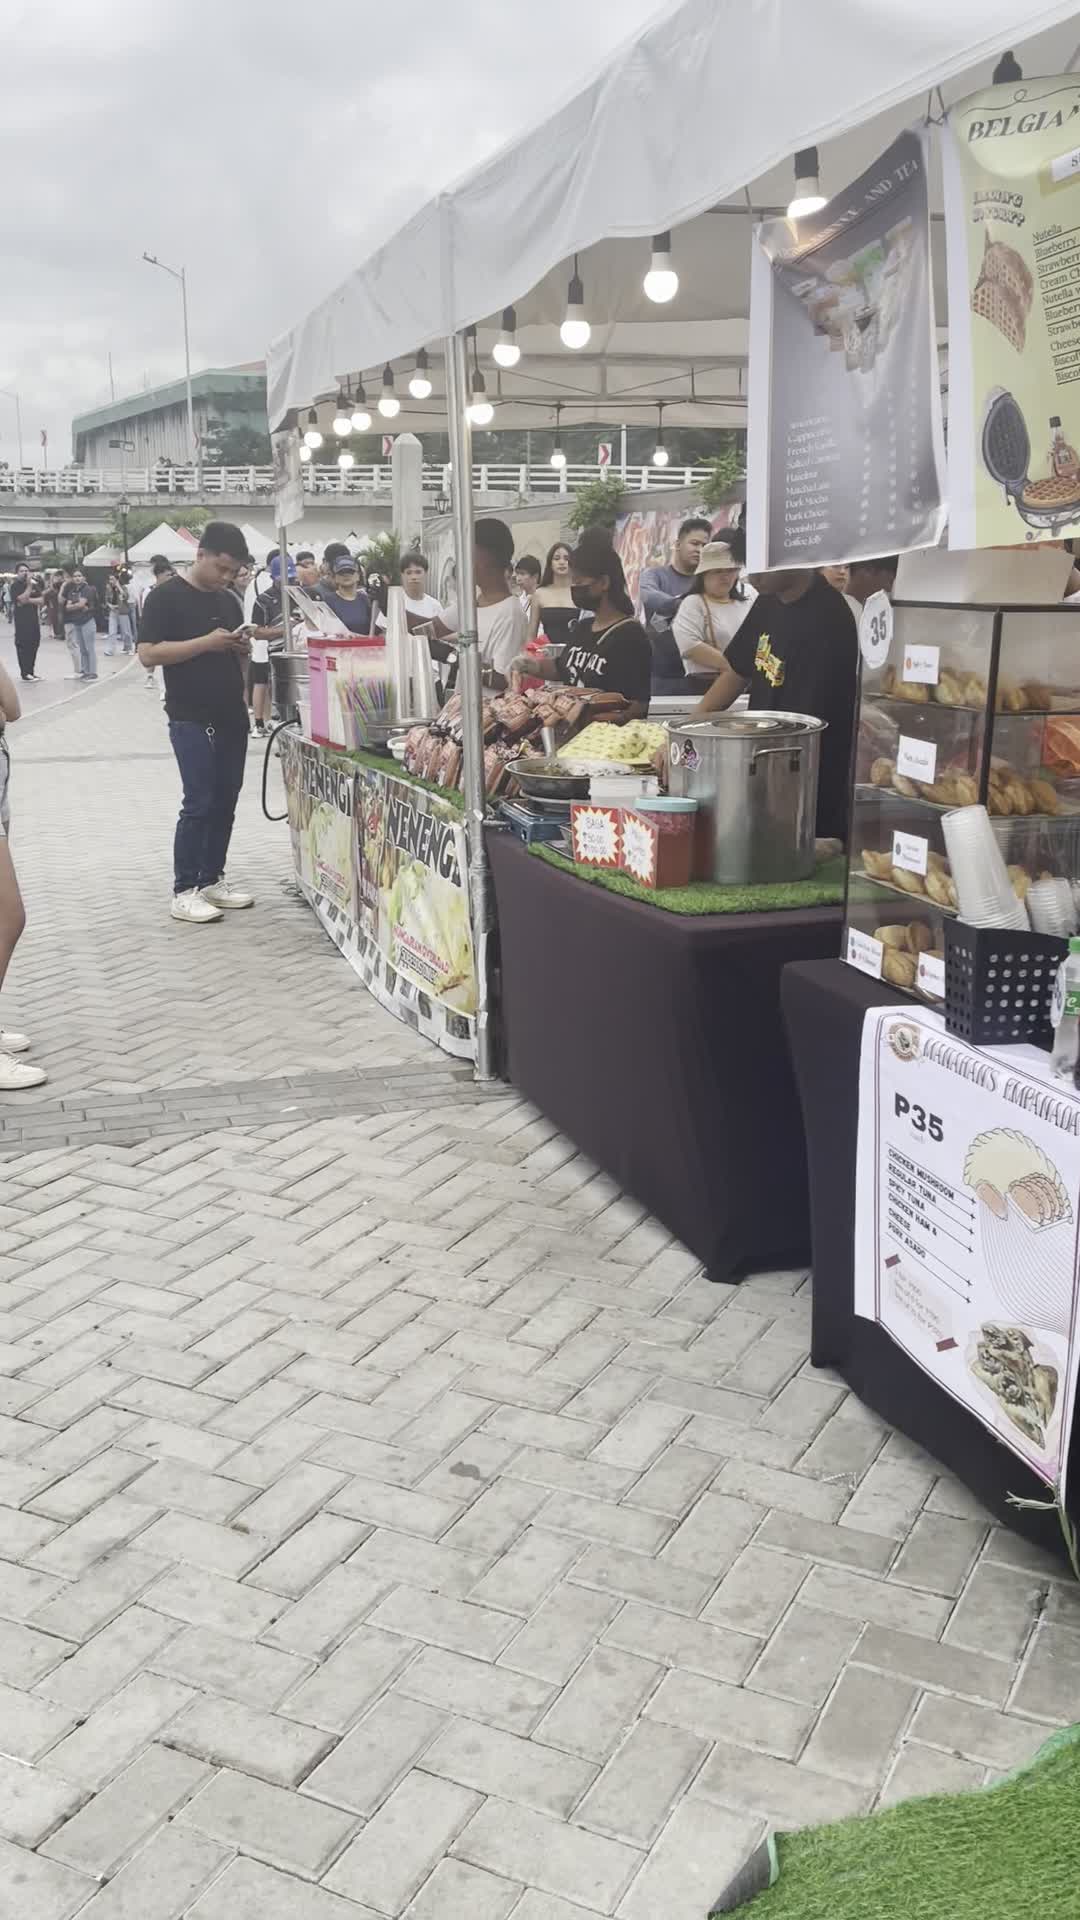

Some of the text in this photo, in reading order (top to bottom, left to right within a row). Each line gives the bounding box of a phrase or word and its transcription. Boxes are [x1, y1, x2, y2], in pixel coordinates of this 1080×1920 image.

[870, 609, 887, 647] 35
[922, 1036, 1000, 1092] MANAHAN'S
[894, 1091, 944, 1143] P35
[888, 1148, 954, 1201] CHICKEN MUSHROOM
[888, 1162, 937, 1204] REGULAR TUNA
[888, 1178, 925, 1212] SPICY TUNA
[888, 1192, 914, 1219] CHICKEN
[915, 1213, 931, 1232] HAM
[888, 1207, 911, 1232] CHEESE
[888, 1221, 926, 1259] PORK ASADO
